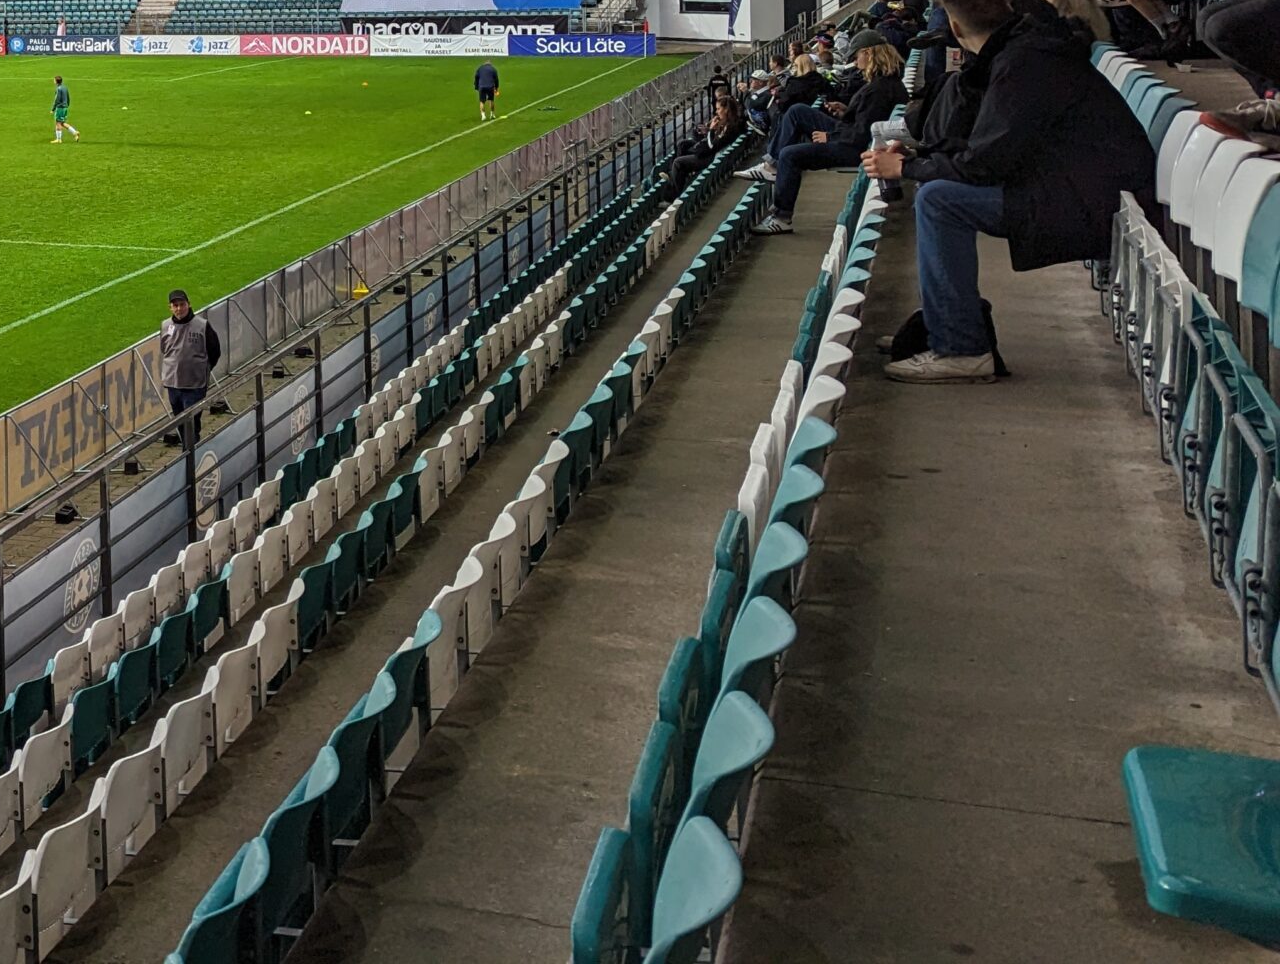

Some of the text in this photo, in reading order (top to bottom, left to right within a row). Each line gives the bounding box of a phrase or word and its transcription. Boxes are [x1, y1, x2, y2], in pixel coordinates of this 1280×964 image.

[352, 21, 438, 36] macron
[52, 37, 116, 53] EuroPark
[148, 41, 169, 52] jazz
[208, 41, 230, 52] jazz
[271, 36, 369, 55] NORDAID
[535, 37, 627, 54] Saku Läte
